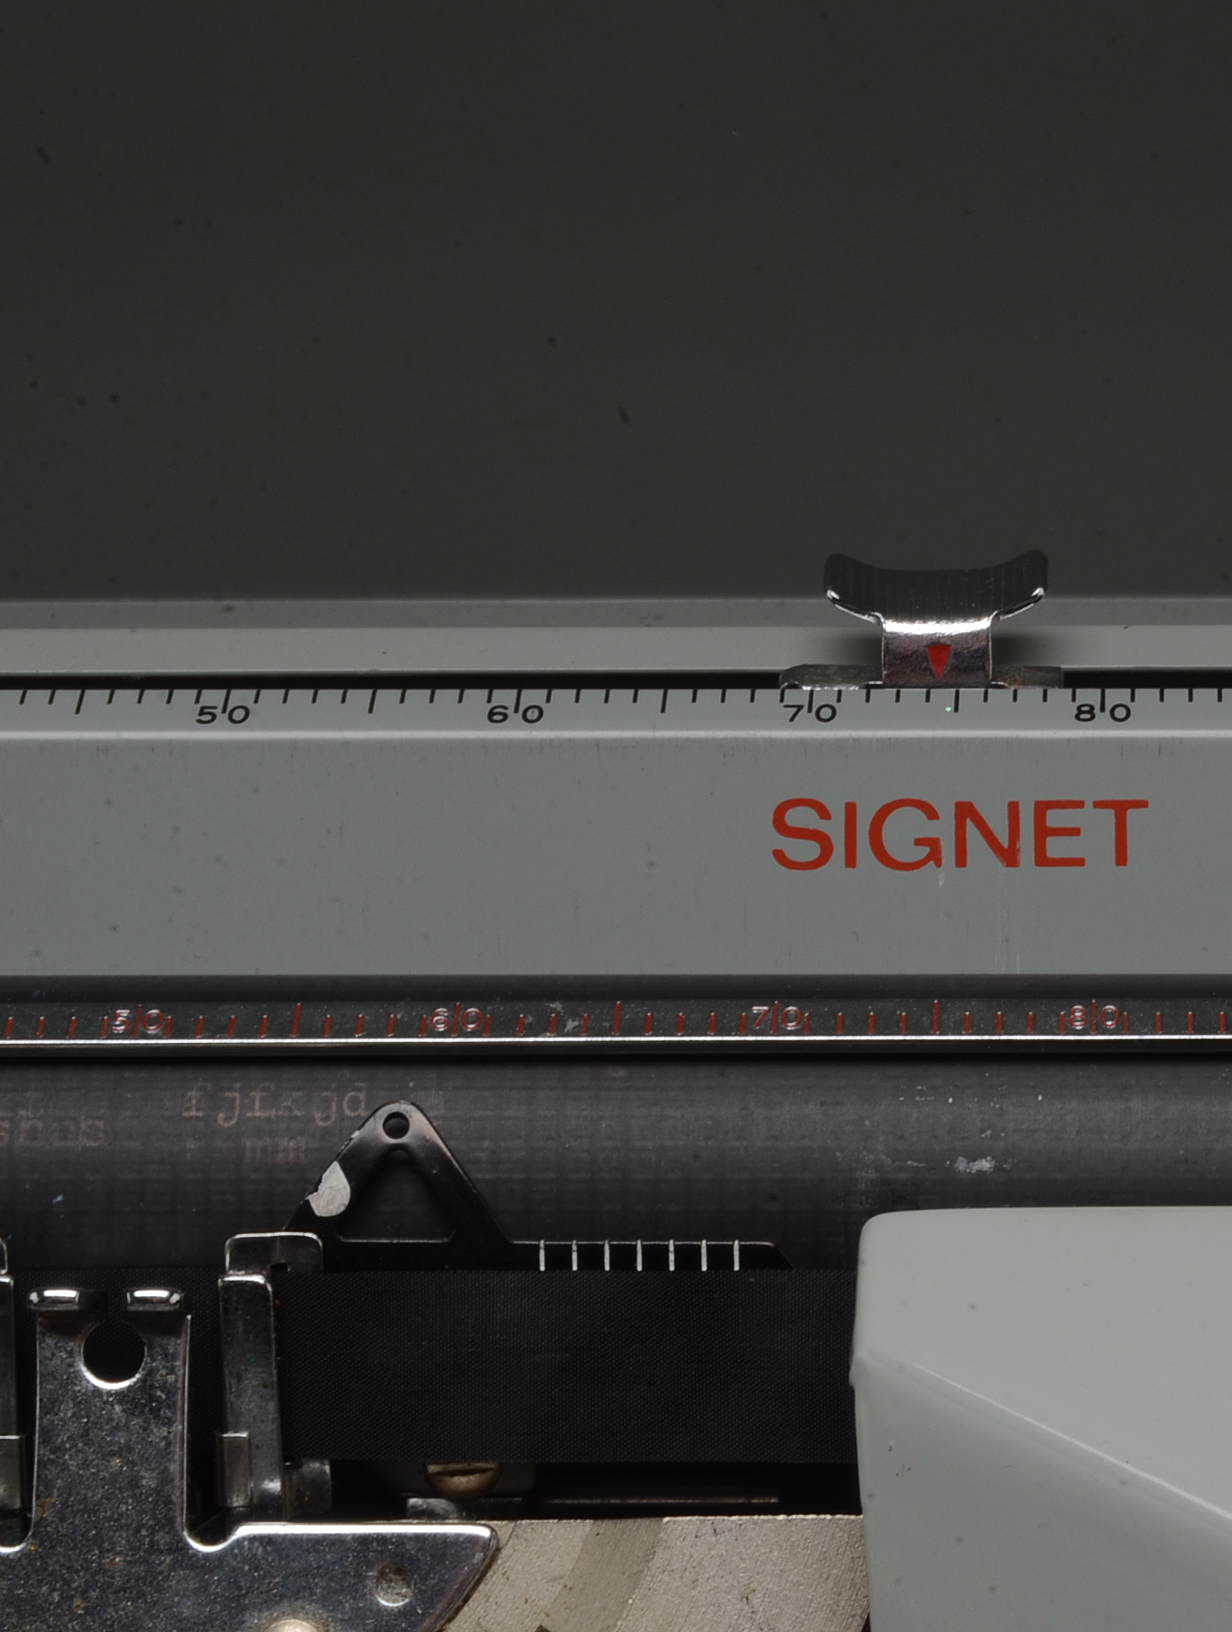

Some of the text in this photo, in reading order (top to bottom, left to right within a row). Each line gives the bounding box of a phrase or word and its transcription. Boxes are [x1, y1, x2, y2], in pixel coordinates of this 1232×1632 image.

[195, 704, 251, 724] 50
[486, 704, 545, 724] 60
[783, 703, 838, 723] 70
[1073, 703, 1132, 723] 80
[771, 797, 1150, 872] SIGNET
[111, 1008, 165, 1035] 50
[431, 1007, 484, 1032] 60
[751, 1005, 803, 1031] 70
[1068, 1004, 1121, 1030] 80
